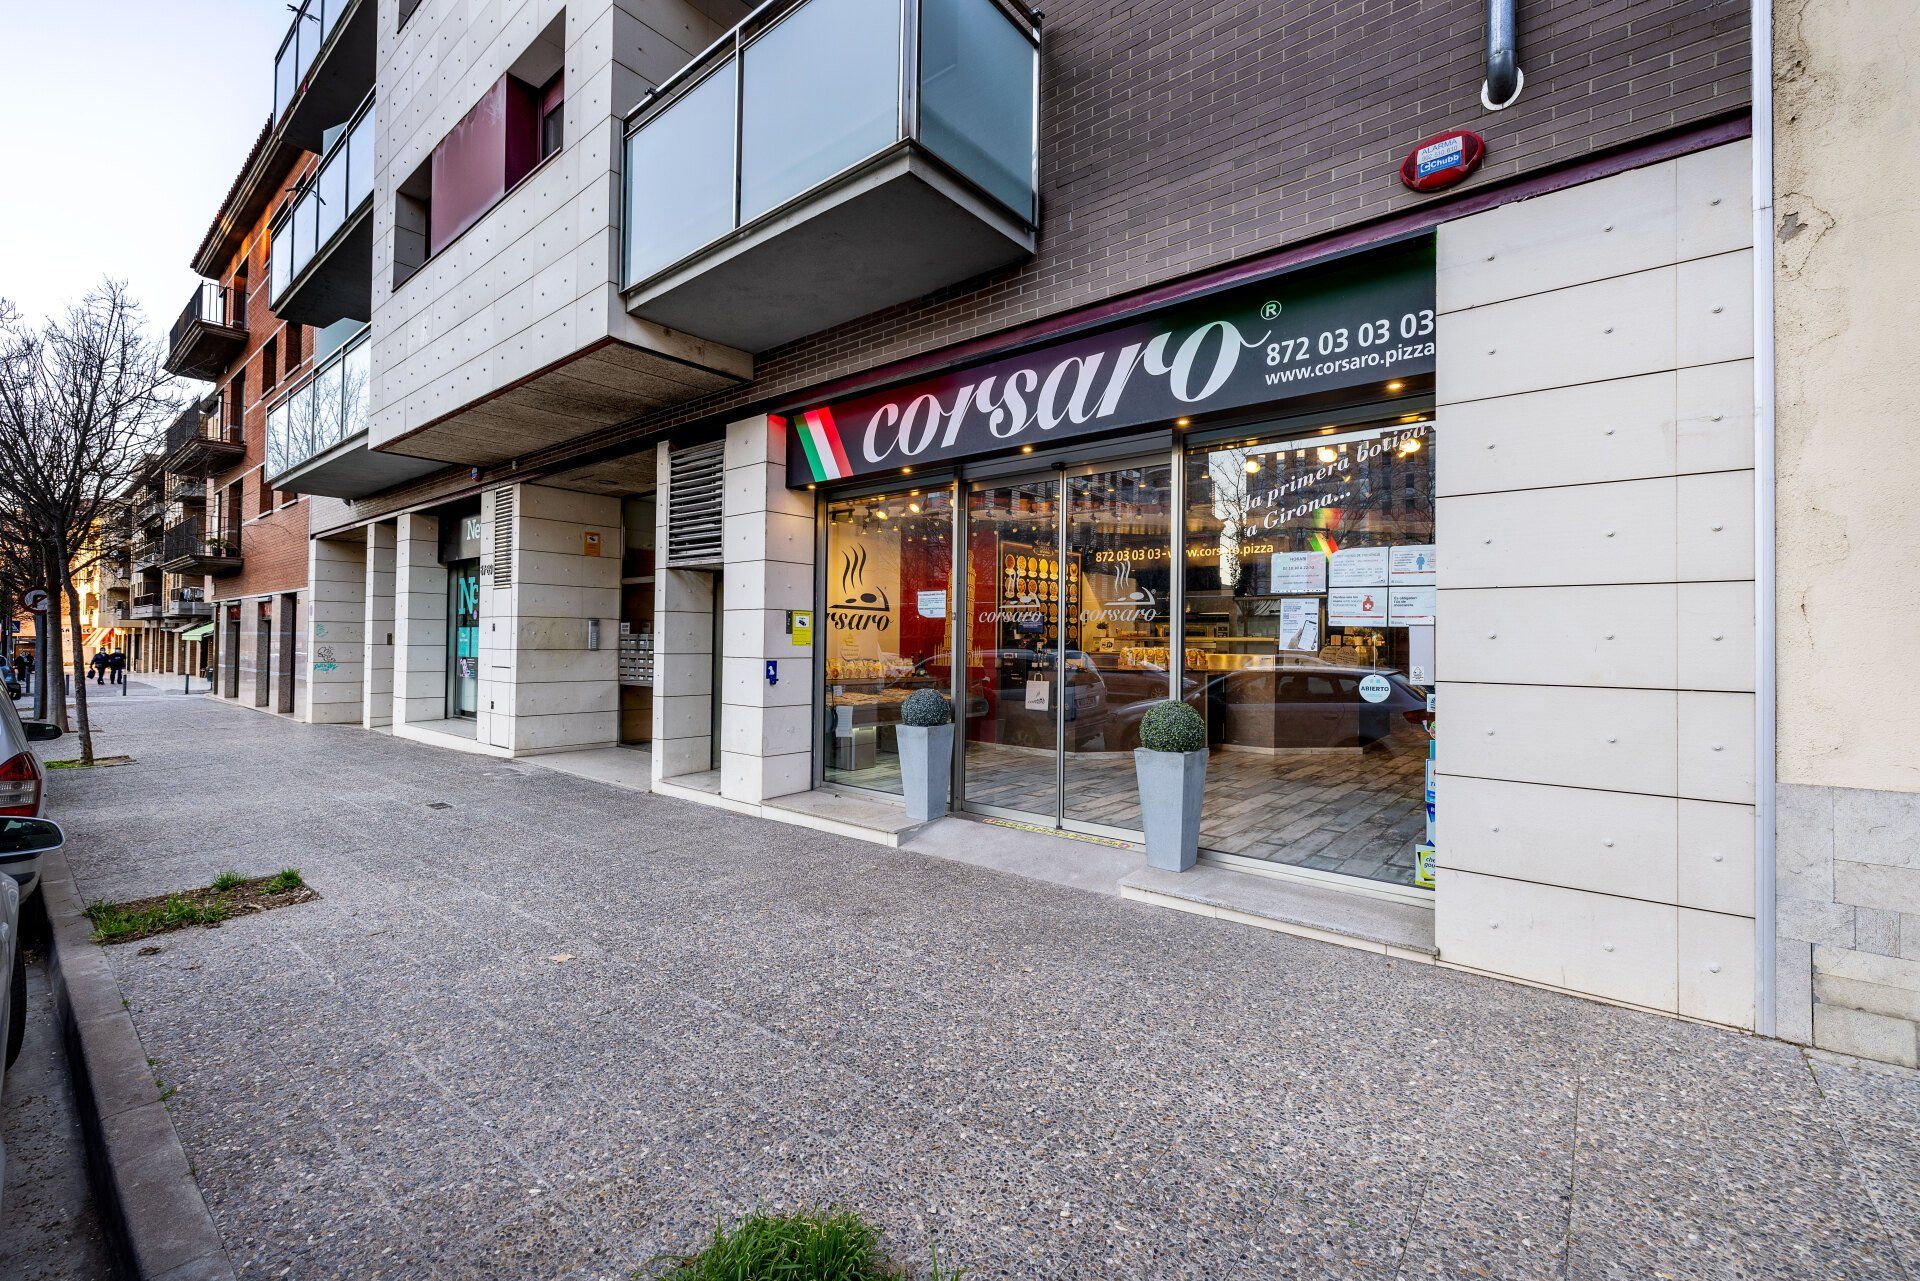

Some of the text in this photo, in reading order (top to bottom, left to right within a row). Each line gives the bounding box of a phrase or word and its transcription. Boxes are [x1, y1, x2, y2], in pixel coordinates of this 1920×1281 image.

[1422, 139, 1458, 155] ALARMA
[1431, 154, 1459, 168] Chubb
[1266, 309, 1434, 366] 872 03 03 03
[1265, 342, 1435, 386] www.corsaro.pizza
[863, 320, 1272, 464] corsaro
[1267, 456, 1349, 508] primera
[1357, 424, 1427, 463] botiga
[1095, 551, 1114, 563] 872
[1117, 550, 1130, 561] 03
[1131, 549, 1145, 561] 03
[979, 610, 1043, 623] corsaro
[1080, 608, 1161, 622] corsaro
